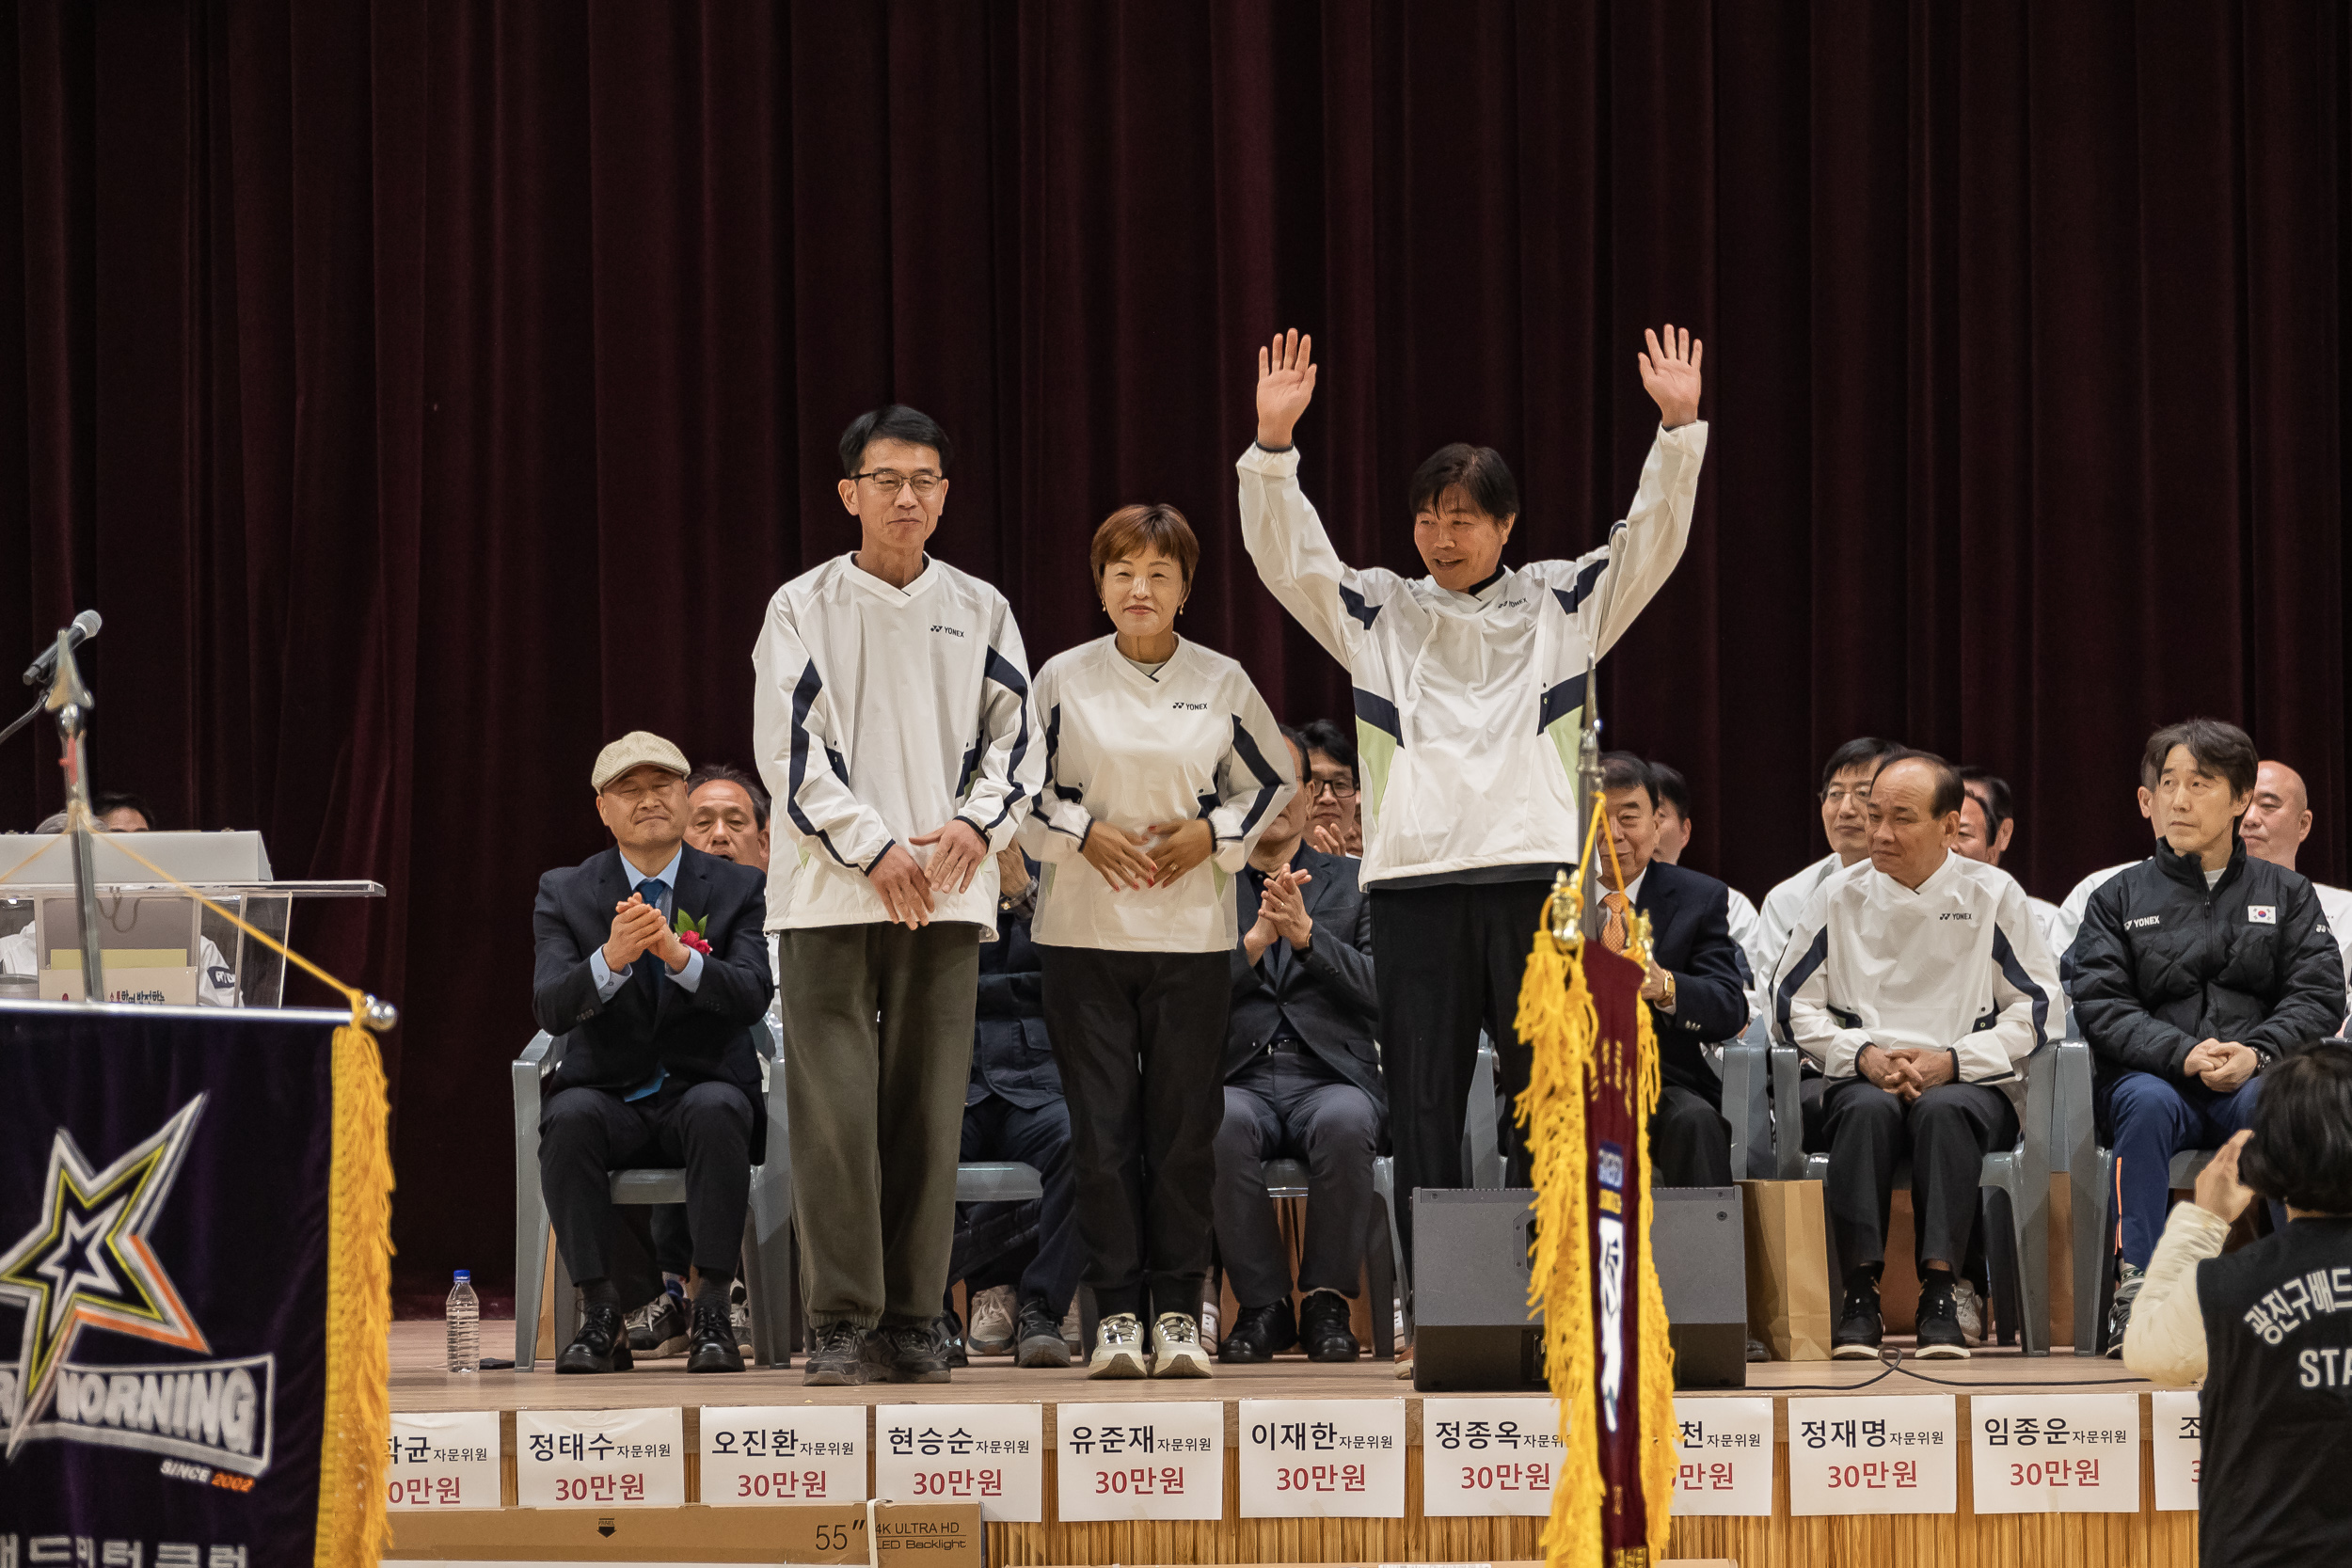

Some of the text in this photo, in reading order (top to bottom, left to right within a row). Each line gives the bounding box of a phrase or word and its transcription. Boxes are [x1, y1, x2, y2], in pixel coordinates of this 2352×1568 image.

[945, 626, 964, 638] YONEX
[1185, 703, 1208, 711] YONEX
[1952, 912, 1972, 921] YONEX
[2133, 915, 2160, 928] YONEX
[711, 1429, 853, 1457] 오진환 자문위원
[888, 1426, 1029, 1455] 현승순 자문위원
[1069, 1425, 1211, 1455] 유준재 자문위원
[1251, 1421, 1392, 1451] 이재한 자문위원
[1435, 1420, 1570, 1449] 정종옥 자문위
[1707, 1433, 1760, 1448] 자문위원
[1800, 1418, 1944, 1449] 정재명 자문위원
[1984, 1418, 2126, 1446] 임종운 자문위원
[433, 1448, 487, 1463] 자문위원
[529, 1433, 671, 1462] 정태수 자문위원
[739, 1470, 826, 1498] 30만원
[914, 1468, 1002, 1497] 30만원
[1096, 1466, 1184, 1496] 30만원
[1277, 1464, 1365, 1492] 30만원
[1461, 1463, 1550, 1491] 30만원
[1672, 1462, 1734, 1491] 만원
[1828, 1460, 1917, 1489] 30만원
[2010, 1458, 2100, 1487] 30만원
[556, 1473, 644, 1501] 30만원
[895, 1523, 938, 1534] ULTRA
[941, 1522, 960, 1533] HD
[905, 1539, 967, 1550] Backlight
